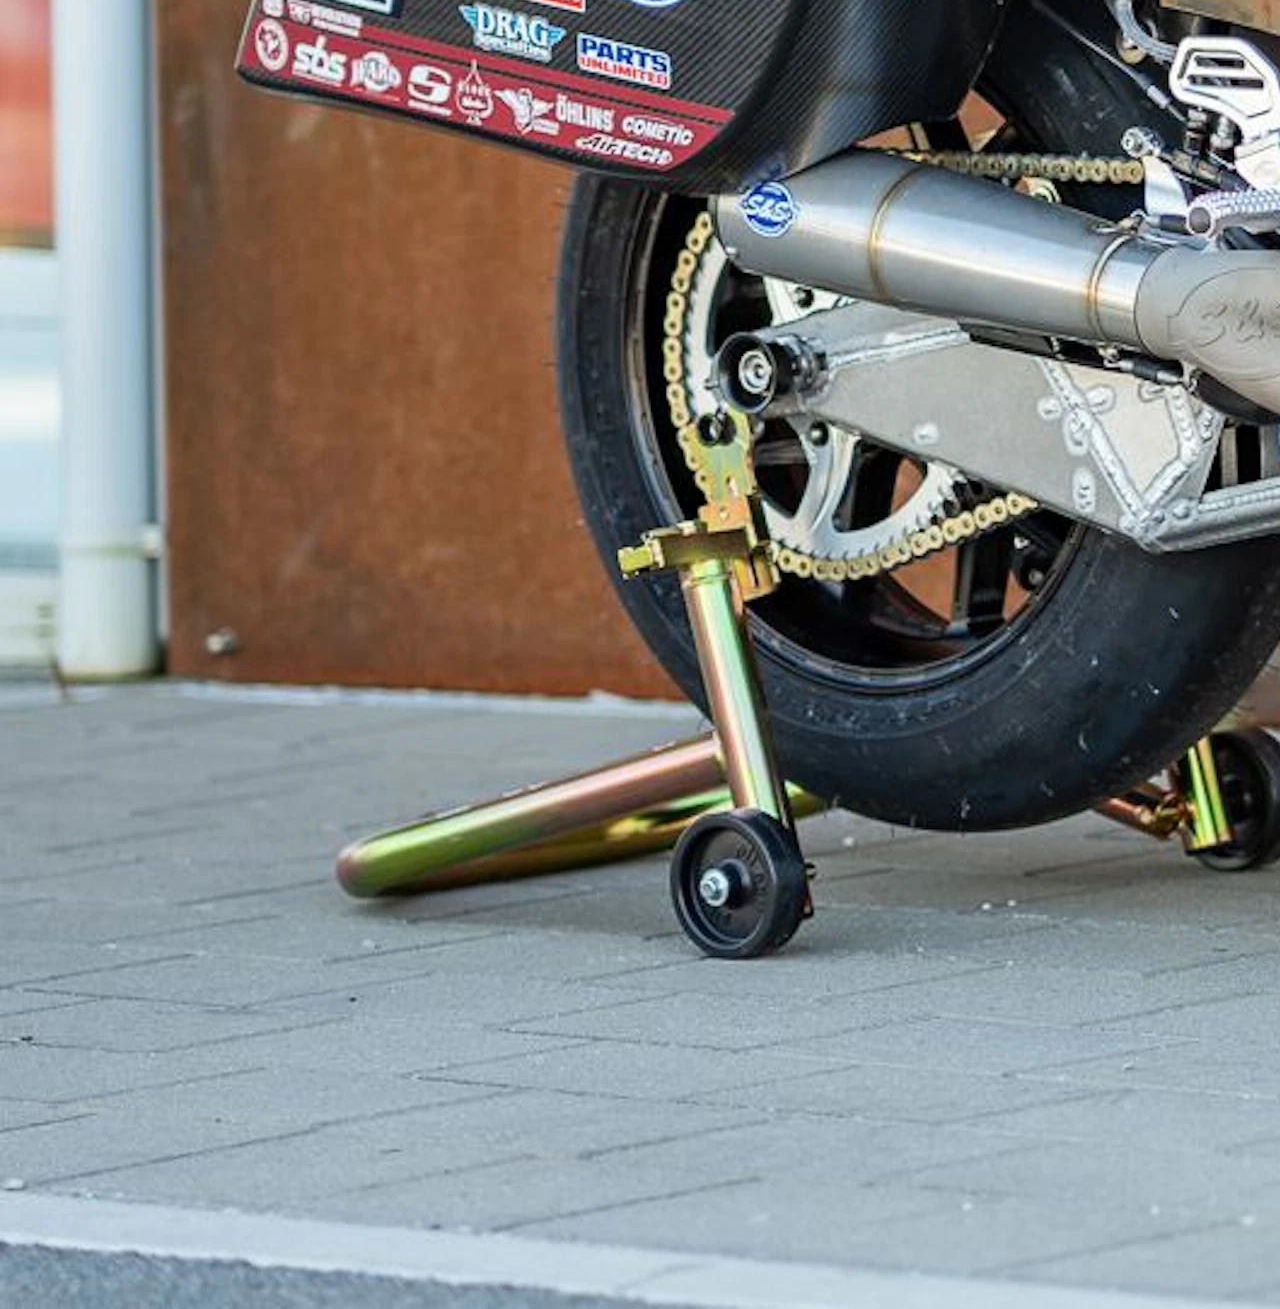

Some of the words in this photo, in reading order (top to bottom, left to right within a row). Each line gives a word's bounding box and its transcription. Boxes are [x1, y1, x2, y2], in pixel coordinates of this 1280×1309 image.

[477, 5, 549, 47] DRAG
[292, 35, 347, 82] sbs
[579, 56, 668, 85] UNLIMITED
[580, 37, 668, 72] PARTS
[555, 93, 615, 132] ÖHLINS
[746, 193, 790, 222] S&S
